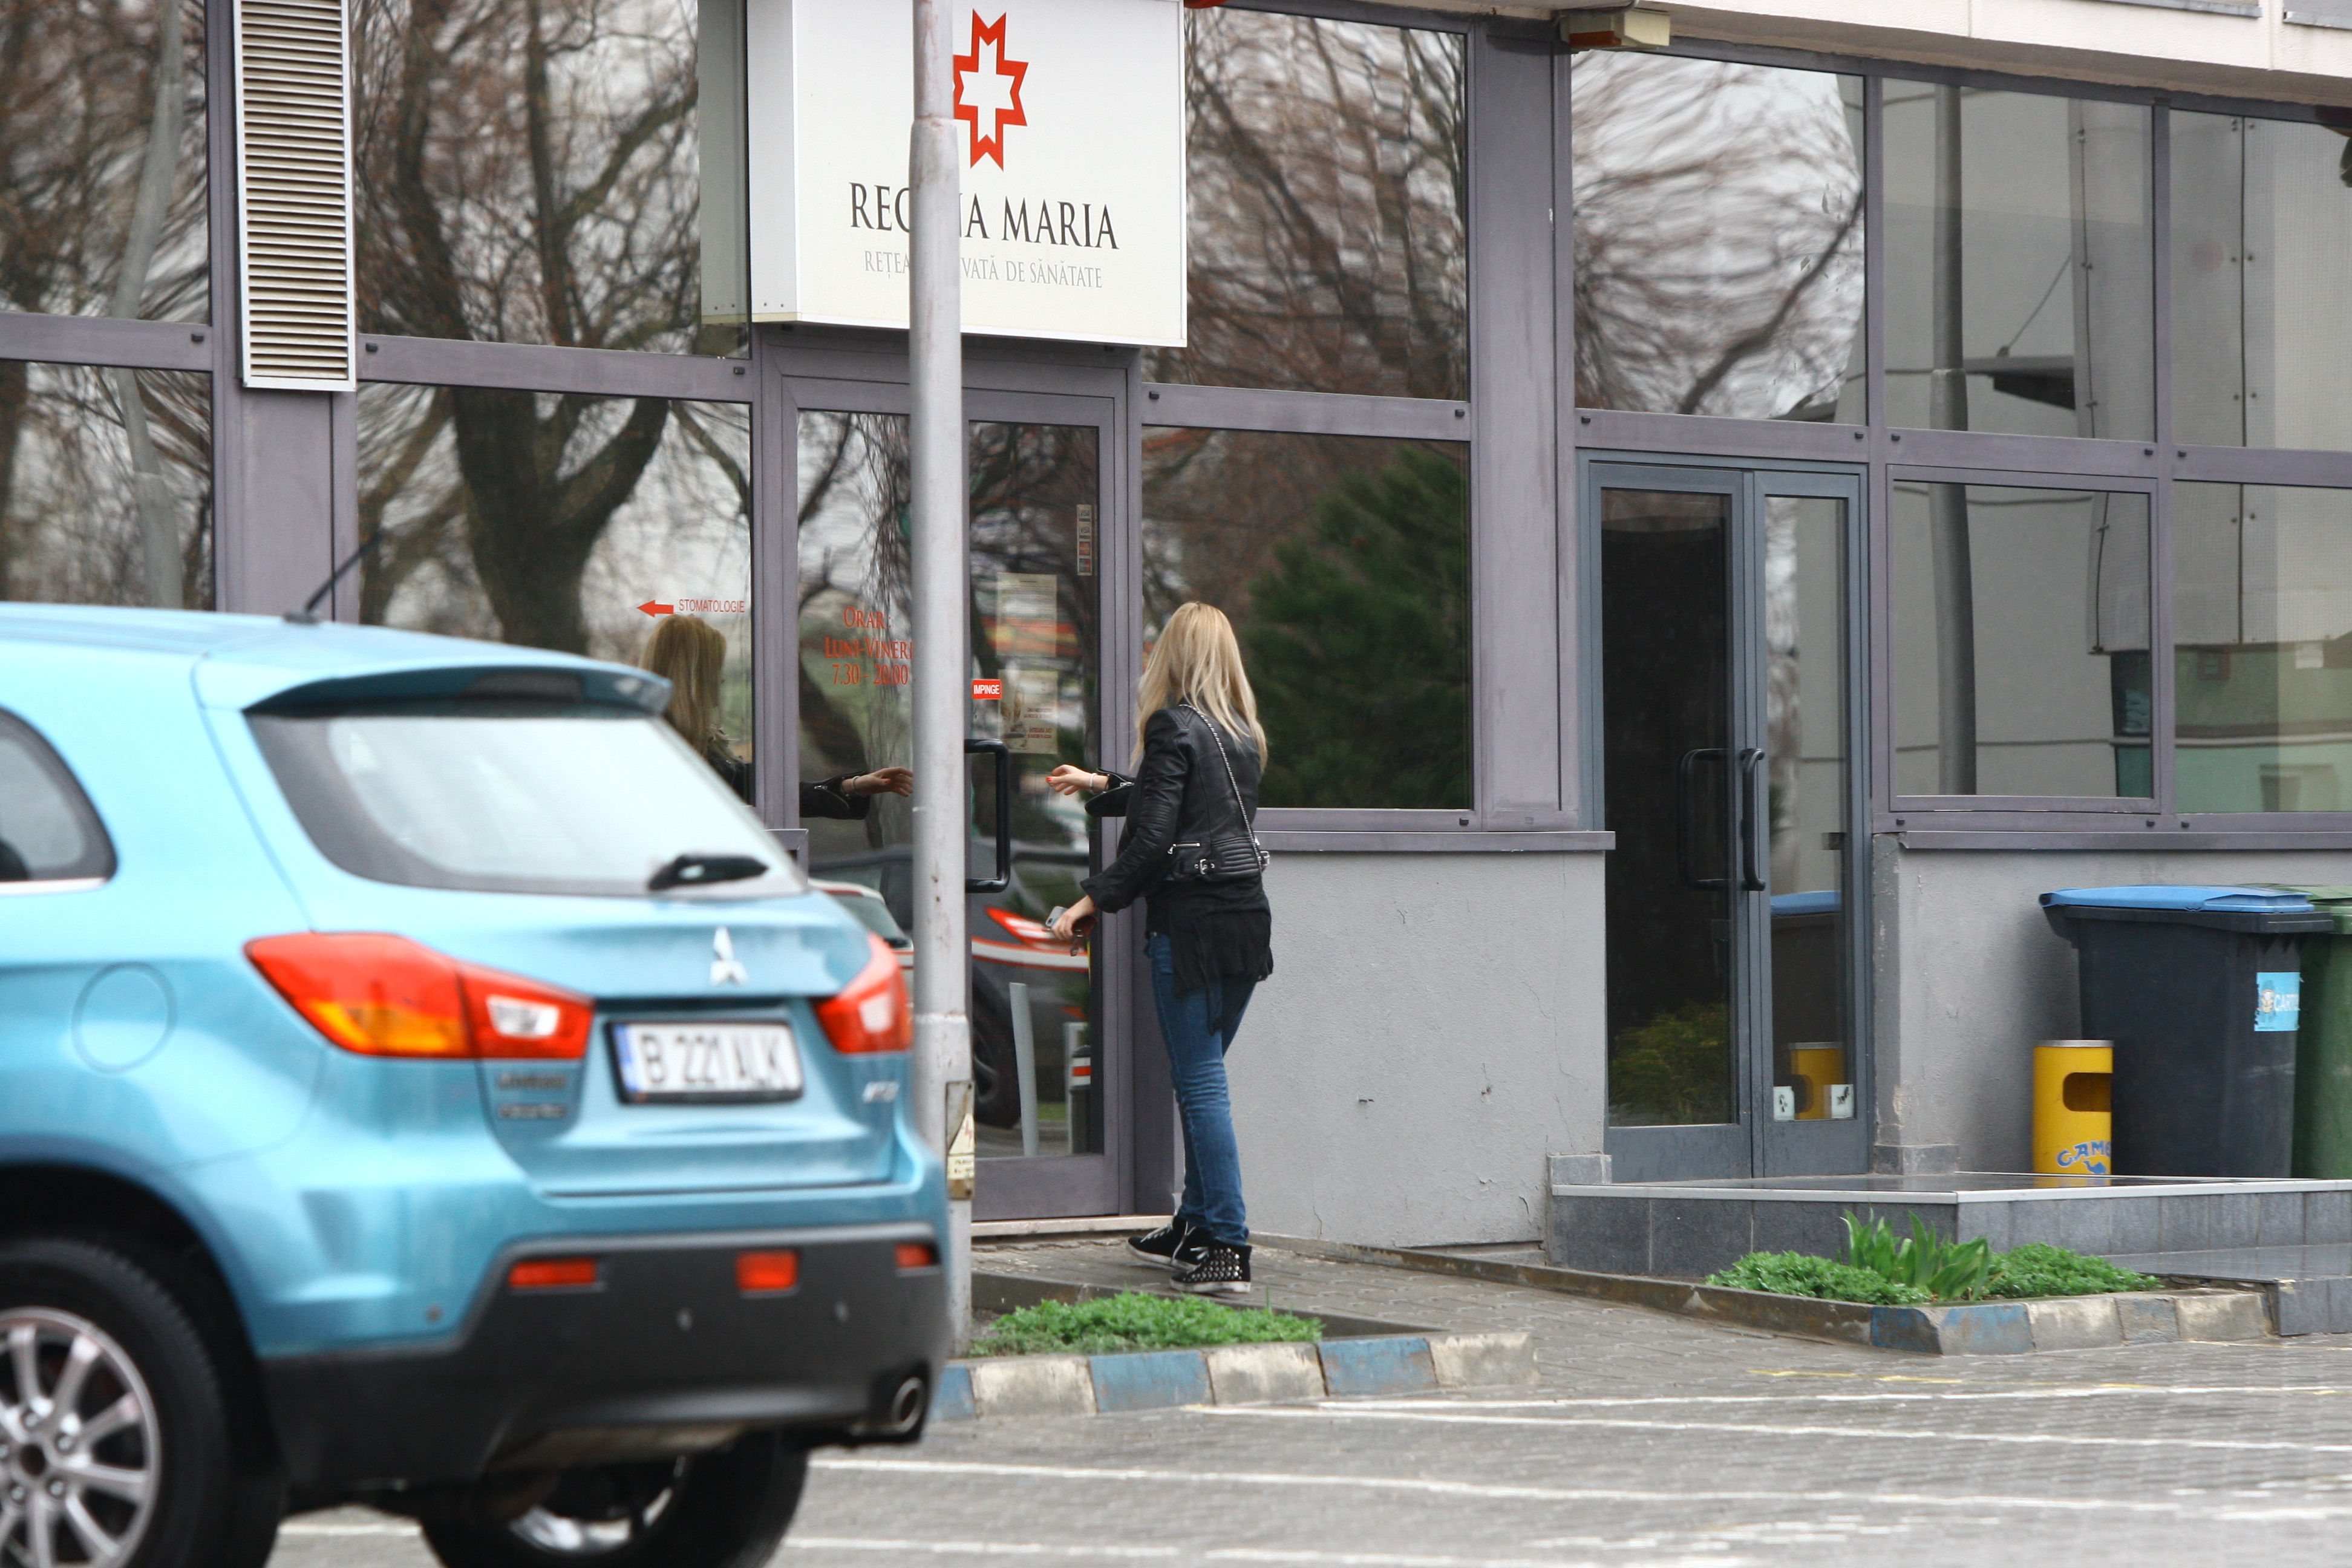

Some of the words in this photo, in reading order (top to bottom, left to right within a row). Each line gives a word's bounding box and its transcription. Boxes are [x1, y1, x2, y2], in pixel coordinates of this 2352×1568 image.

[1001, 196, 1120, 249] MARIA
[960, 255, 999, 281] VATĂ
[1005, 260, 1025, 283] DE
[1030, 258, 1103, 289] SĂNĂTATE
[679, 599, 745, 613] STOMATOLOGIE
[832, 663, 860, 685] 7.30
[874, 664, 910, 685] 20.00
[973, 684, 1000, 694] IMPINGE
[640, 1033, 668, 1084] B
